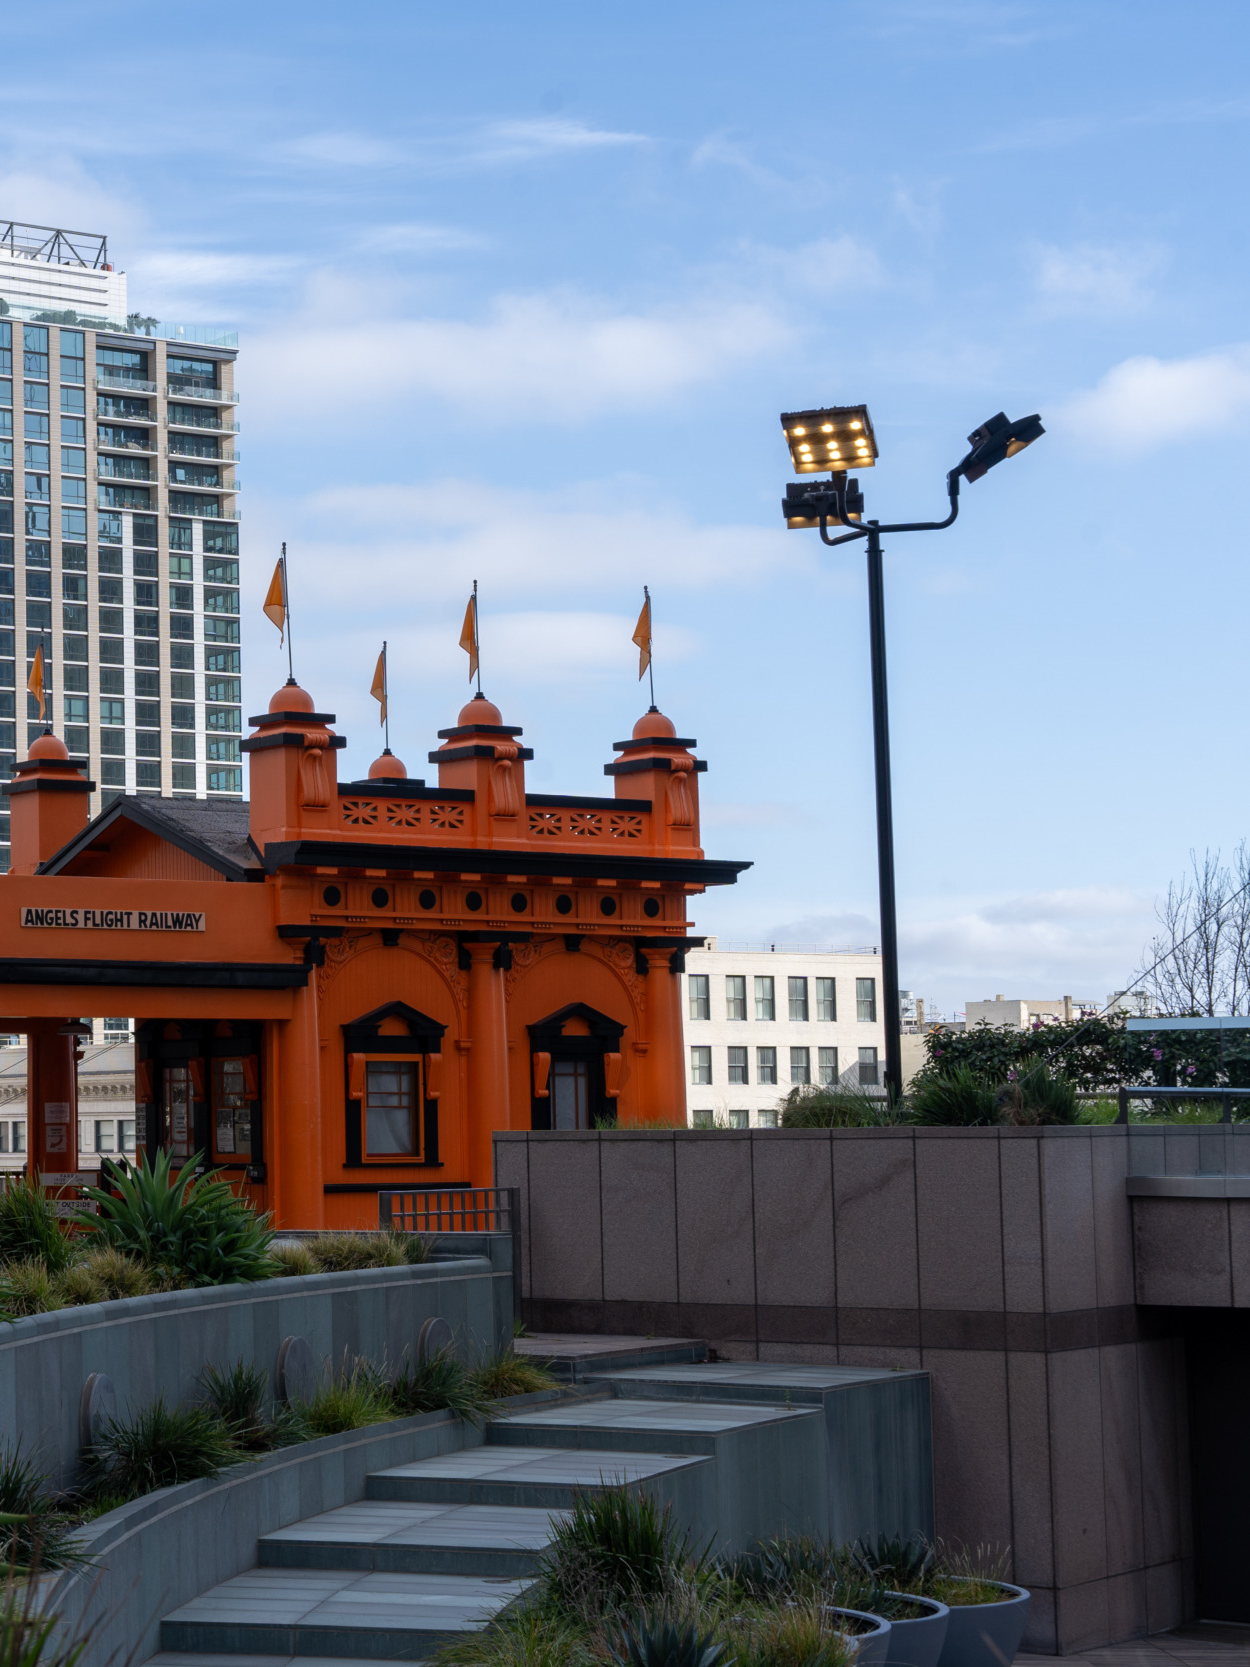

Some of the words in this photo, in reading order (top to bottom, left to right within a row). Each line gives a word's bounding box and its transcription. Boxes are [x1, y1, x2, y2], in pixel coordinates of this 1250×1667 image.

[25, 909, 79, 927] ANGELS
[84, 910, 133, 928] FLIGHT
[138, 912, 202, 929] RAILWAY
